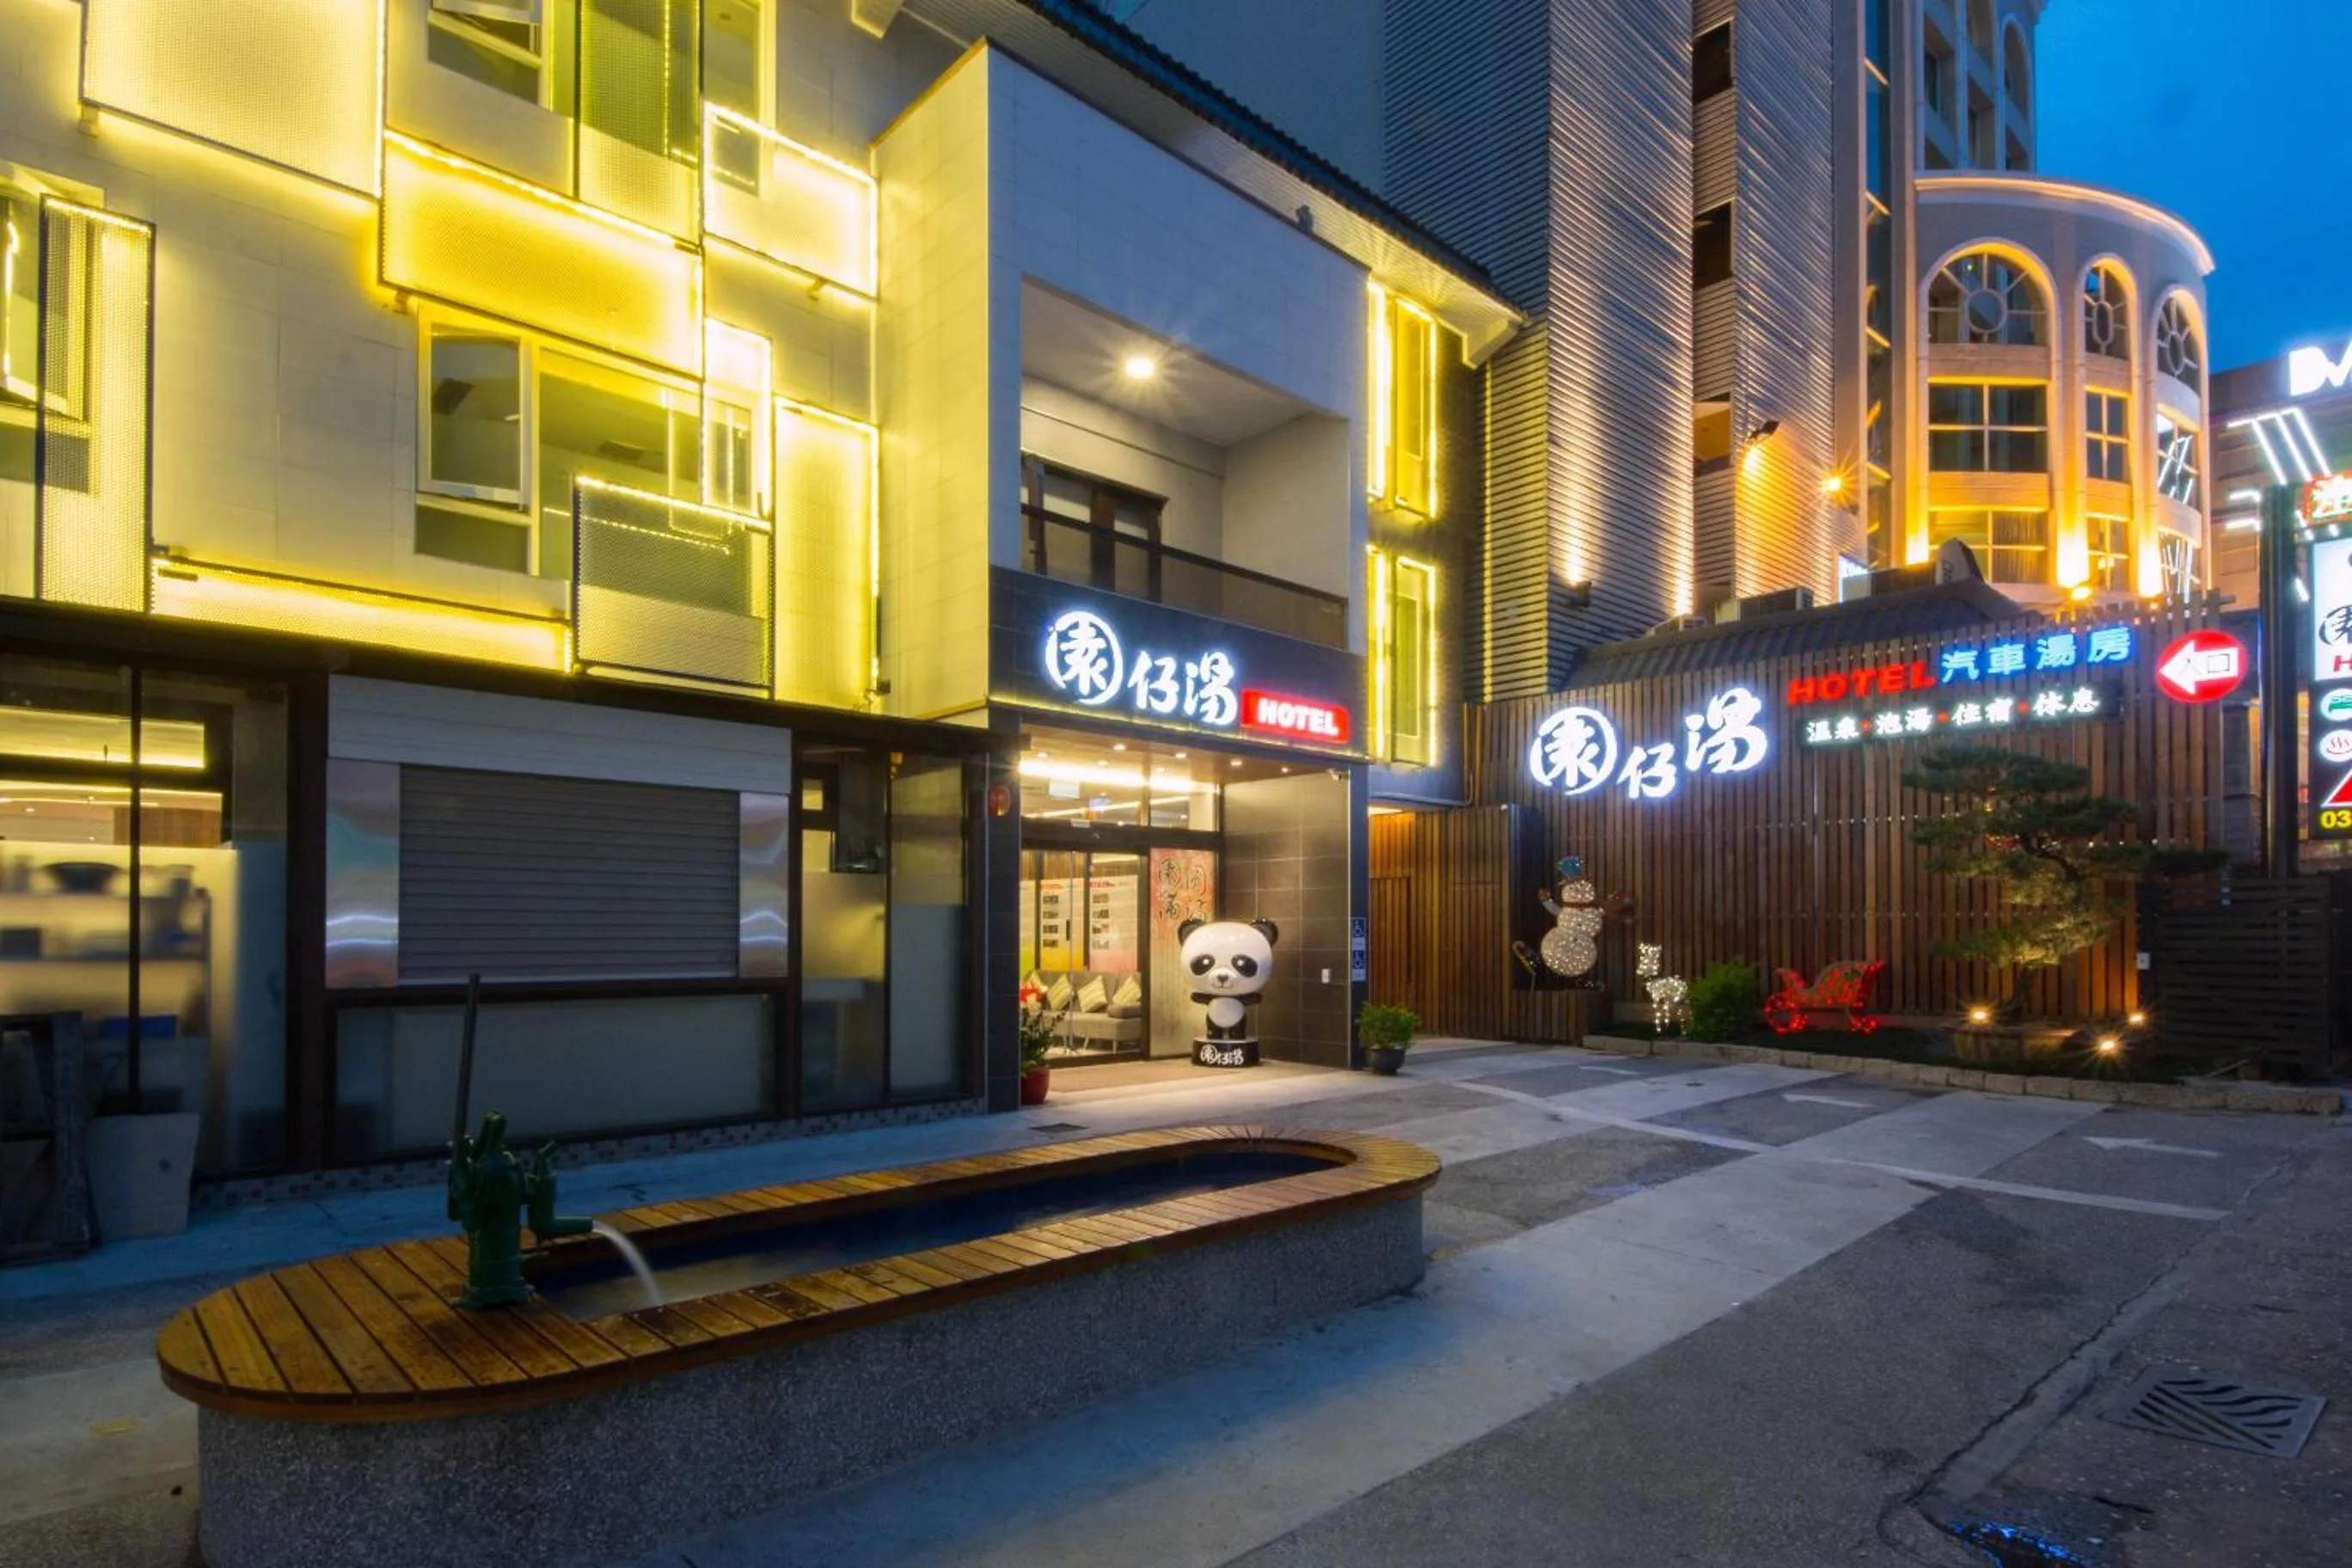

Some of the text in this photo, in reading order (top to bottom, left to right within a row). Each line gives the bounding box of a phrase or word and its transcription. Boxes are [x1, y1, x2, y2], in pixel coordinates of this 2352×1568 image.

[1787, 626, 2133, 704] HOTEL 汽車湯房
[1258, 700, 1338, 736] HOTEL
